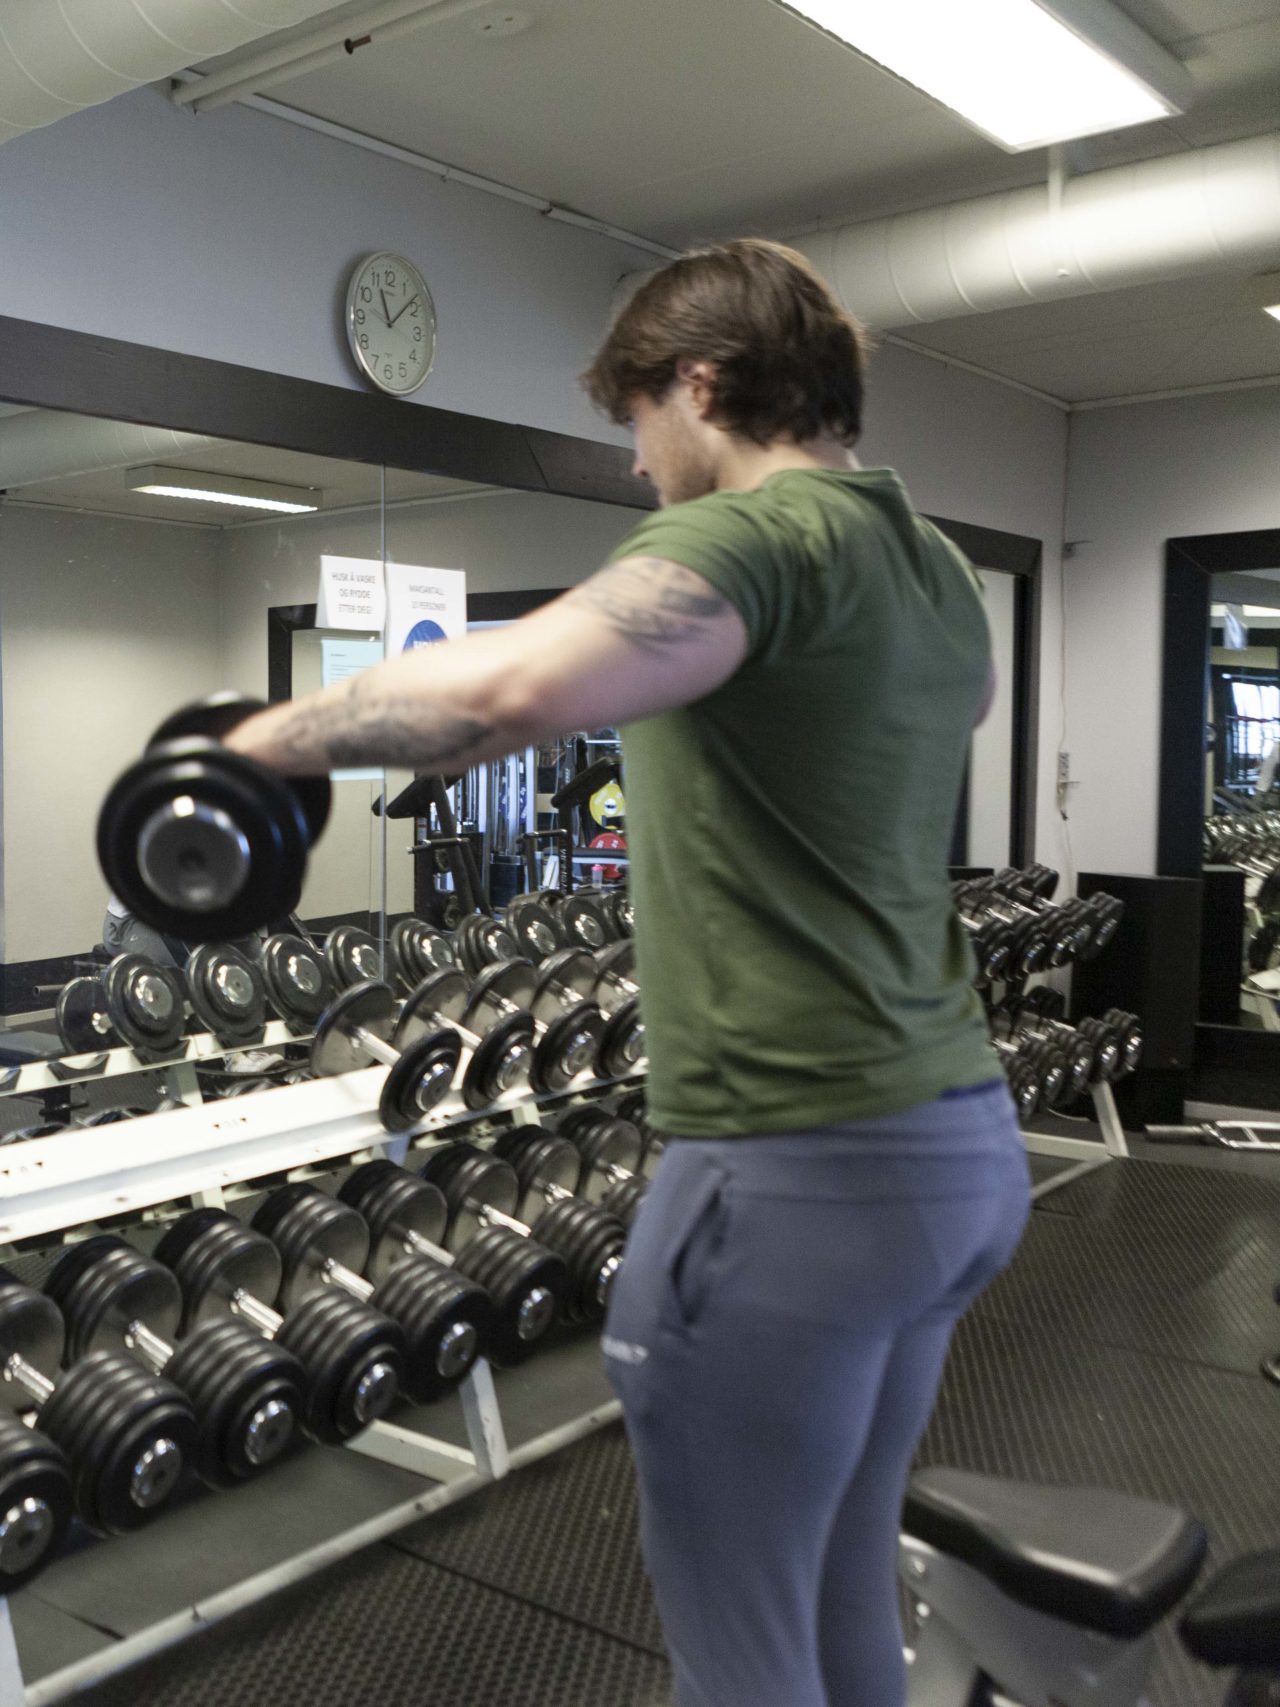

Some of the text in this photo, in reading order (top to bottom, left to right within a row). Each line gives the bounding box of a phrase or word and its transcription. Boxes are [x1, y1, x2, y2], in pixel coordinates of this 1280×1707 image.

[371, 271, 380, 288] 11
[384, 270, 396, 288] 12
[360, 286, 372, 303] 10
[402, 282, 407, 296] 1
[356, 308, 365, 325] 9
[409, 300, 418, 318] 2
[360, 333, 369, 350] 8
[413, 326, 422, 342] 3
[371, 354, 380, 369] 7
[408, 348, 417, 363] 4
[383, 364, 393, 380] 6
[398, 362, 407, 378] 5
[339, 588, 348, 598] OG
